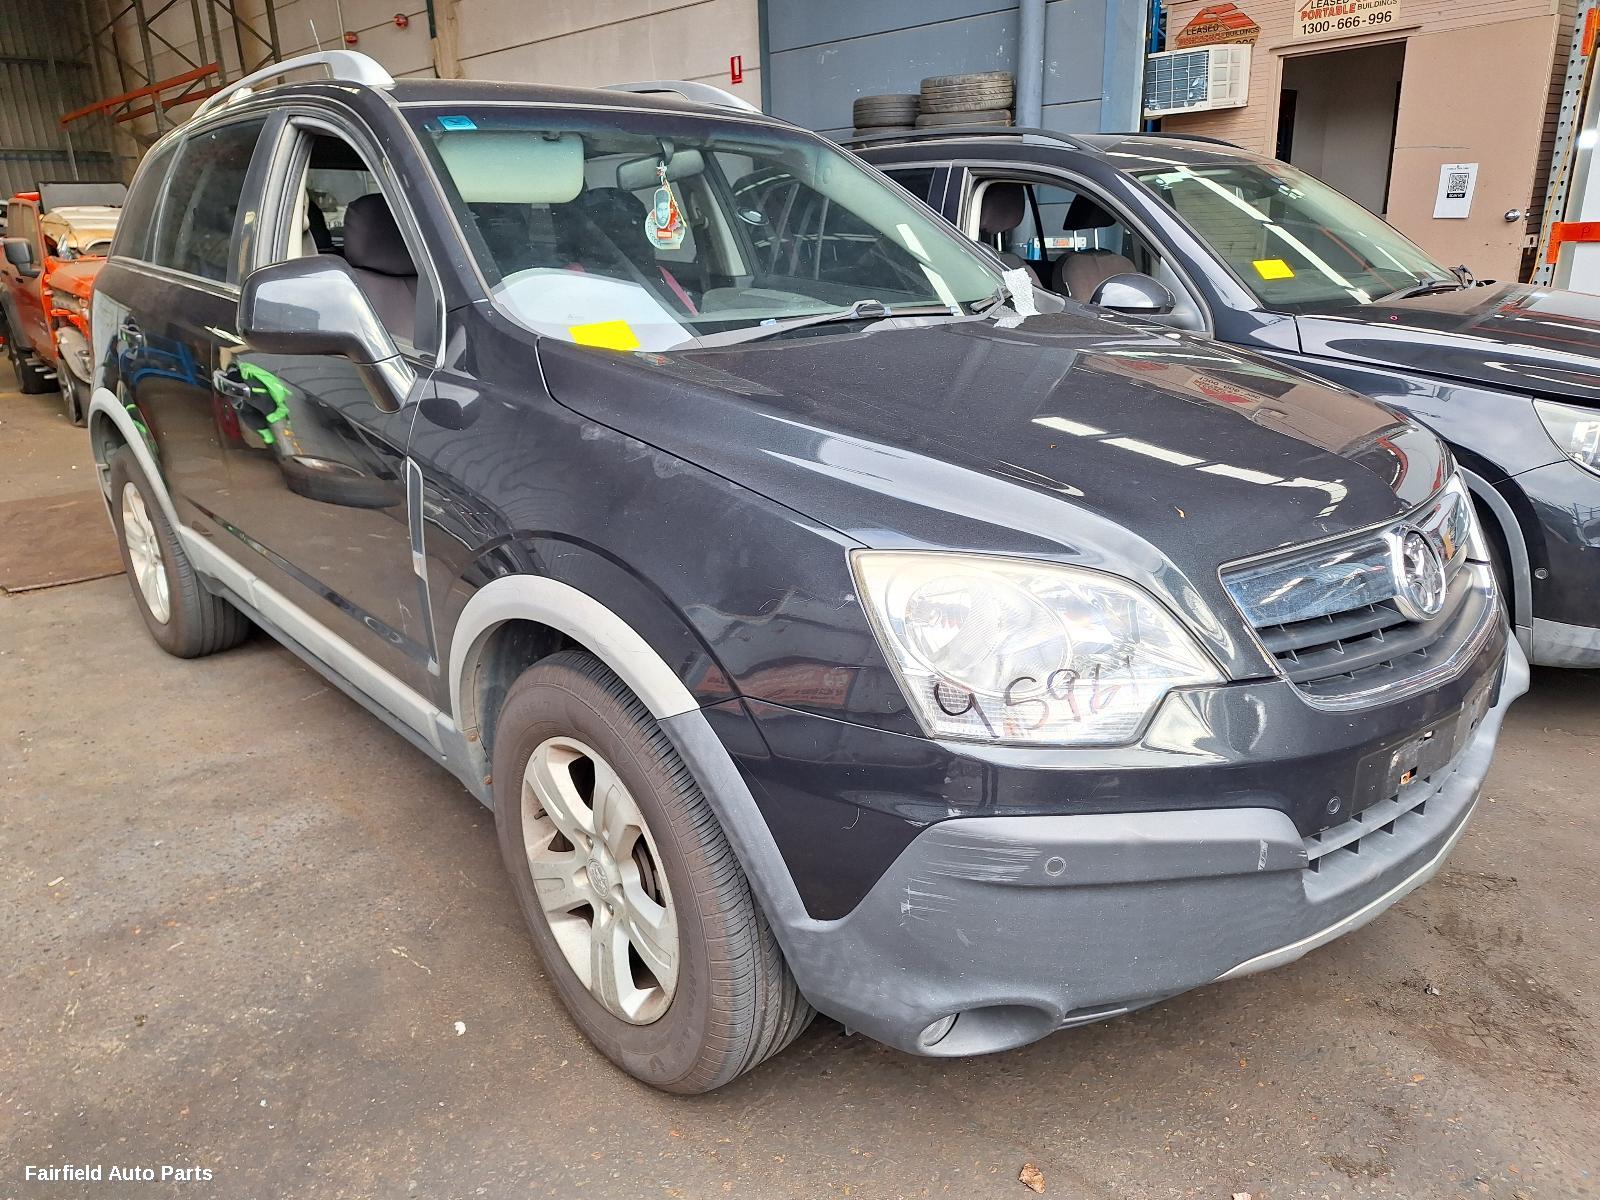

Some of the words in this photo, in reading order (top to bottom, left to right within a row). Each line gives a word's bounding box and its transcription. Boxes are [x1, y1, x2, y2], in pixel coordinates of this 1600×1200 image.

[1301, 3, 1356, 21] PORTABLE
[1357, 0, 1398, 10] BUILDINGS
[1186, 24, 1219, 36] LEASED
[1302, 11, 1392, 35] 1300-666-996
